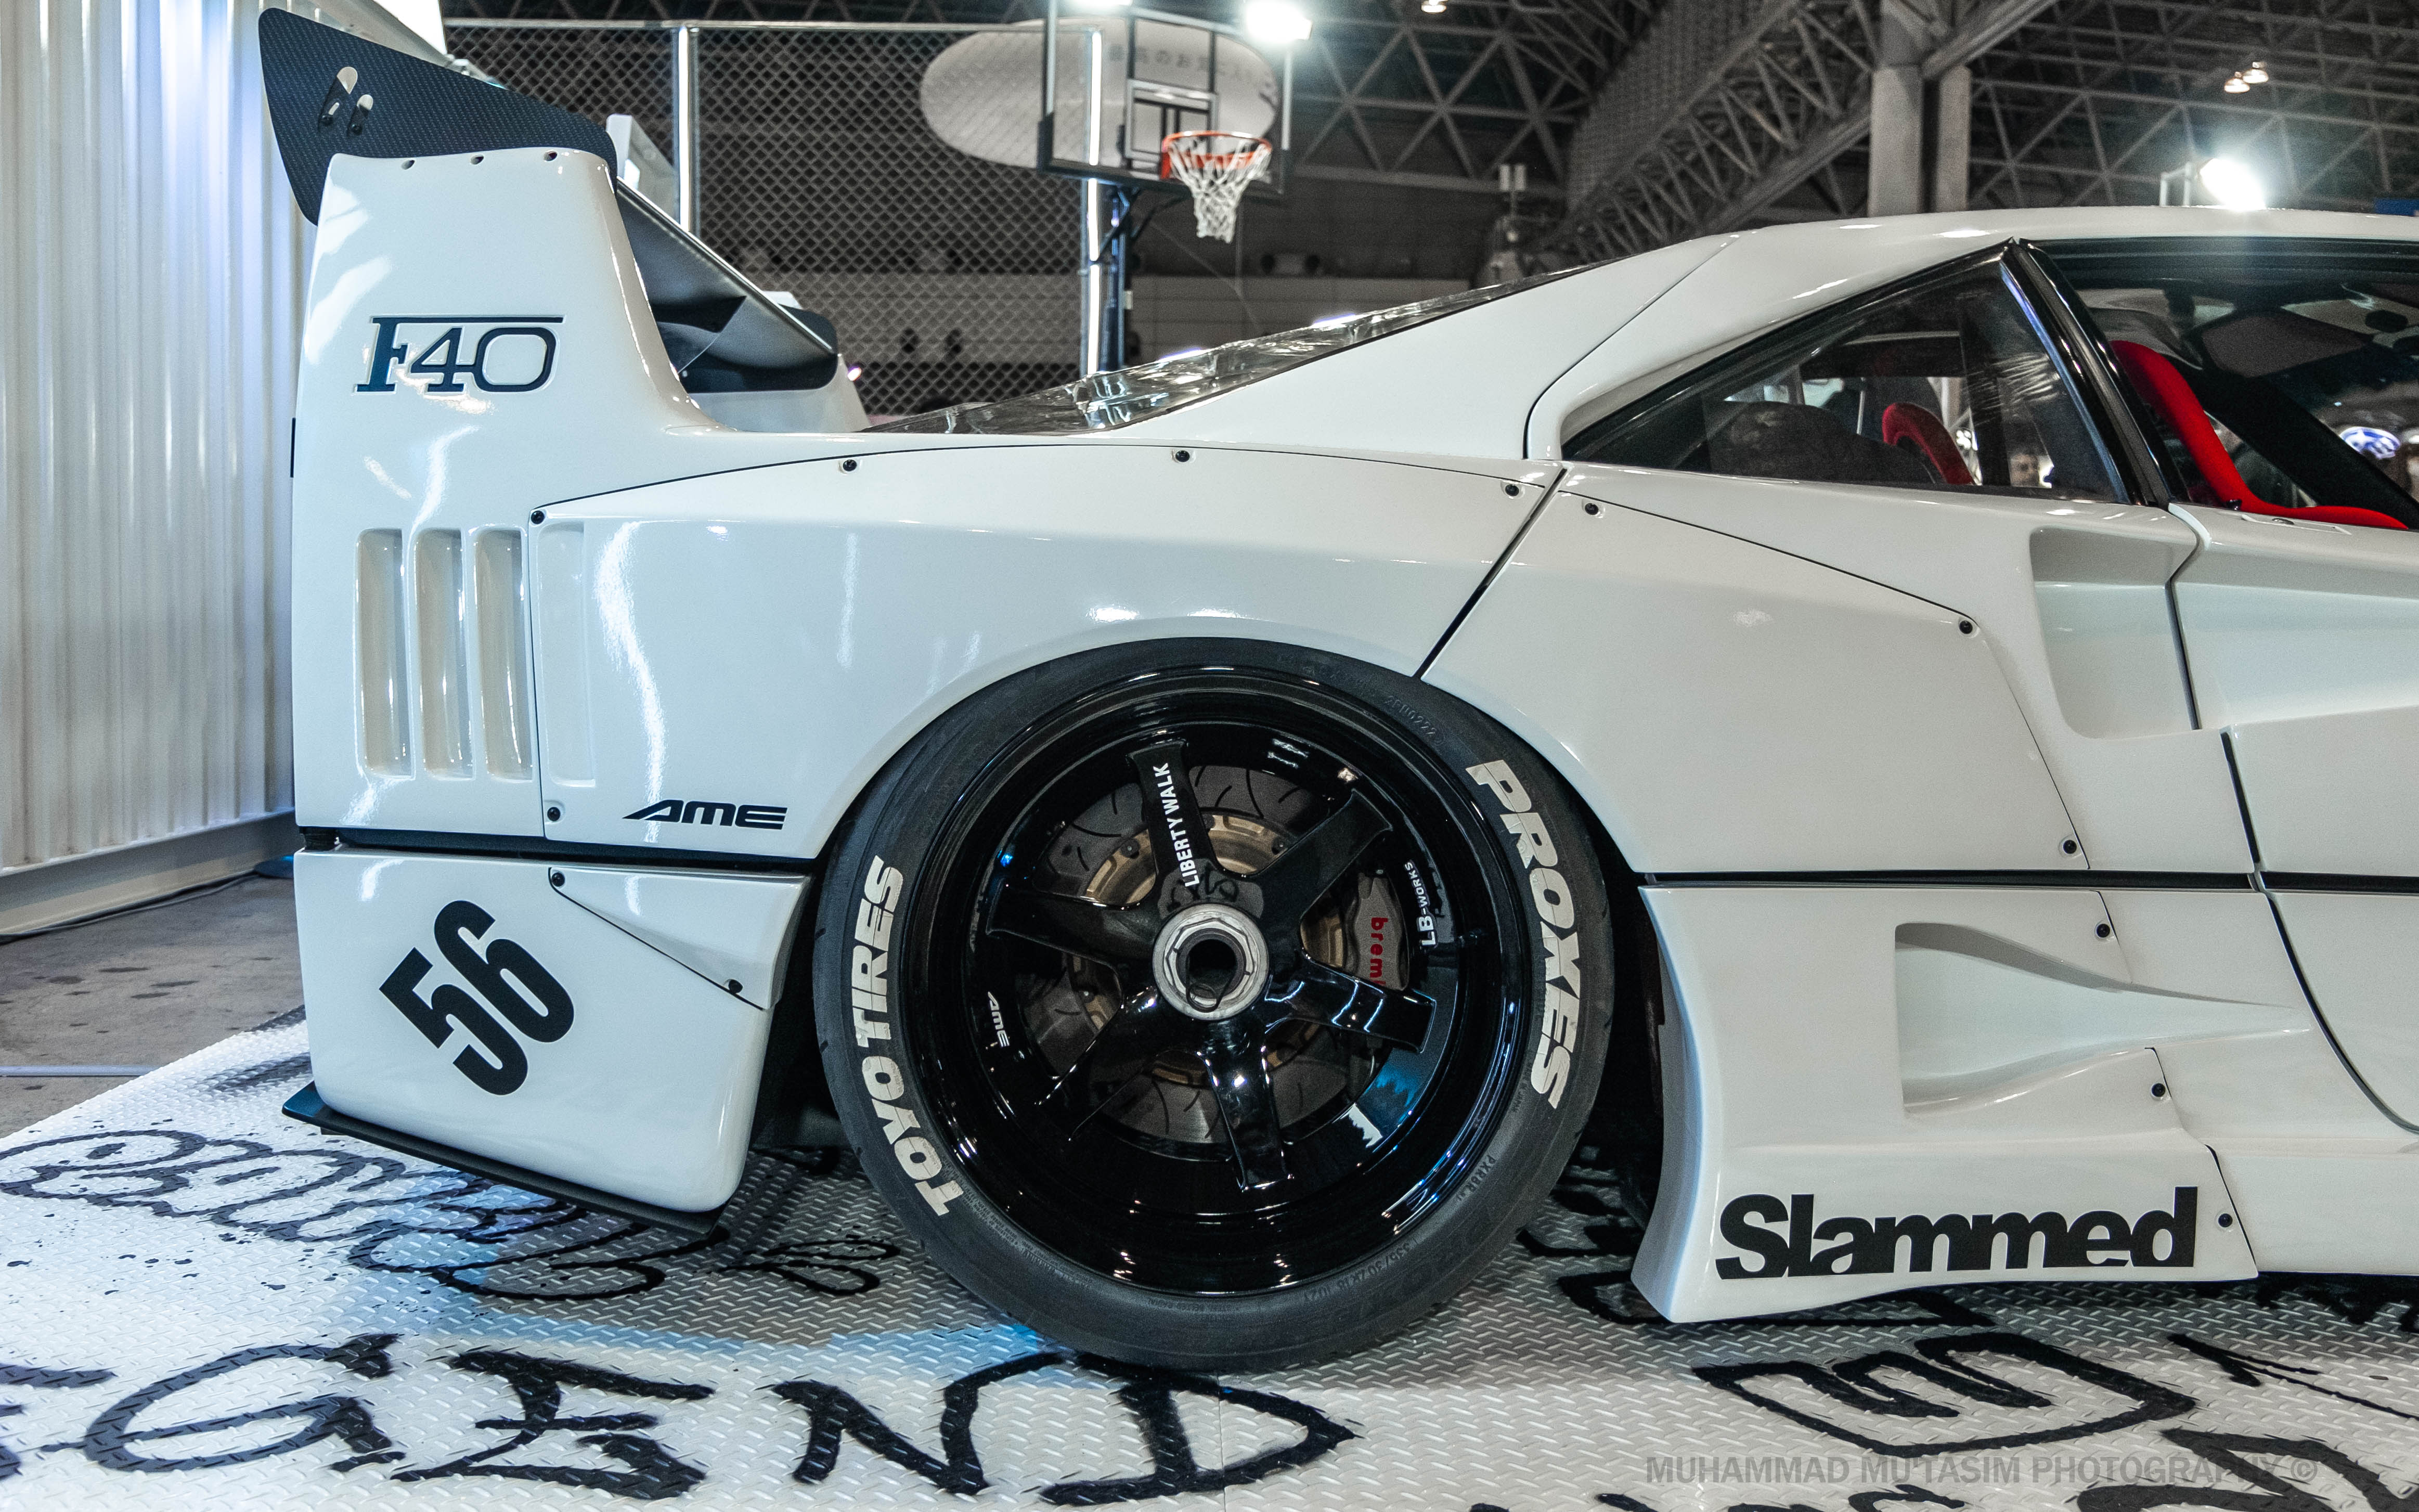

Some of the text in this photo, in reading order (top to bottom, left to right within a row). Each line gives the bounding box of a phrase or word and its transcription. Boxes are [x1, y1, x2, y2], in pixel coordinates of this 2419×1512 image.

[356, 317, 564, 392] F40
[623, 799, 787, 830] AME
[1153, 763, 1199, 886] LIBERTY WALK
[1405, 861, 1437, 946] LB-WORKS
[1465, 760, 1580, 1109] PROXES
[379, 900, 574, 1095] 56
[852, 855, 964, 1216] TOYO TIRES
[988, 991, 1010, 1047] AME
[1715, 1186, 2198, 1280] Slammed
